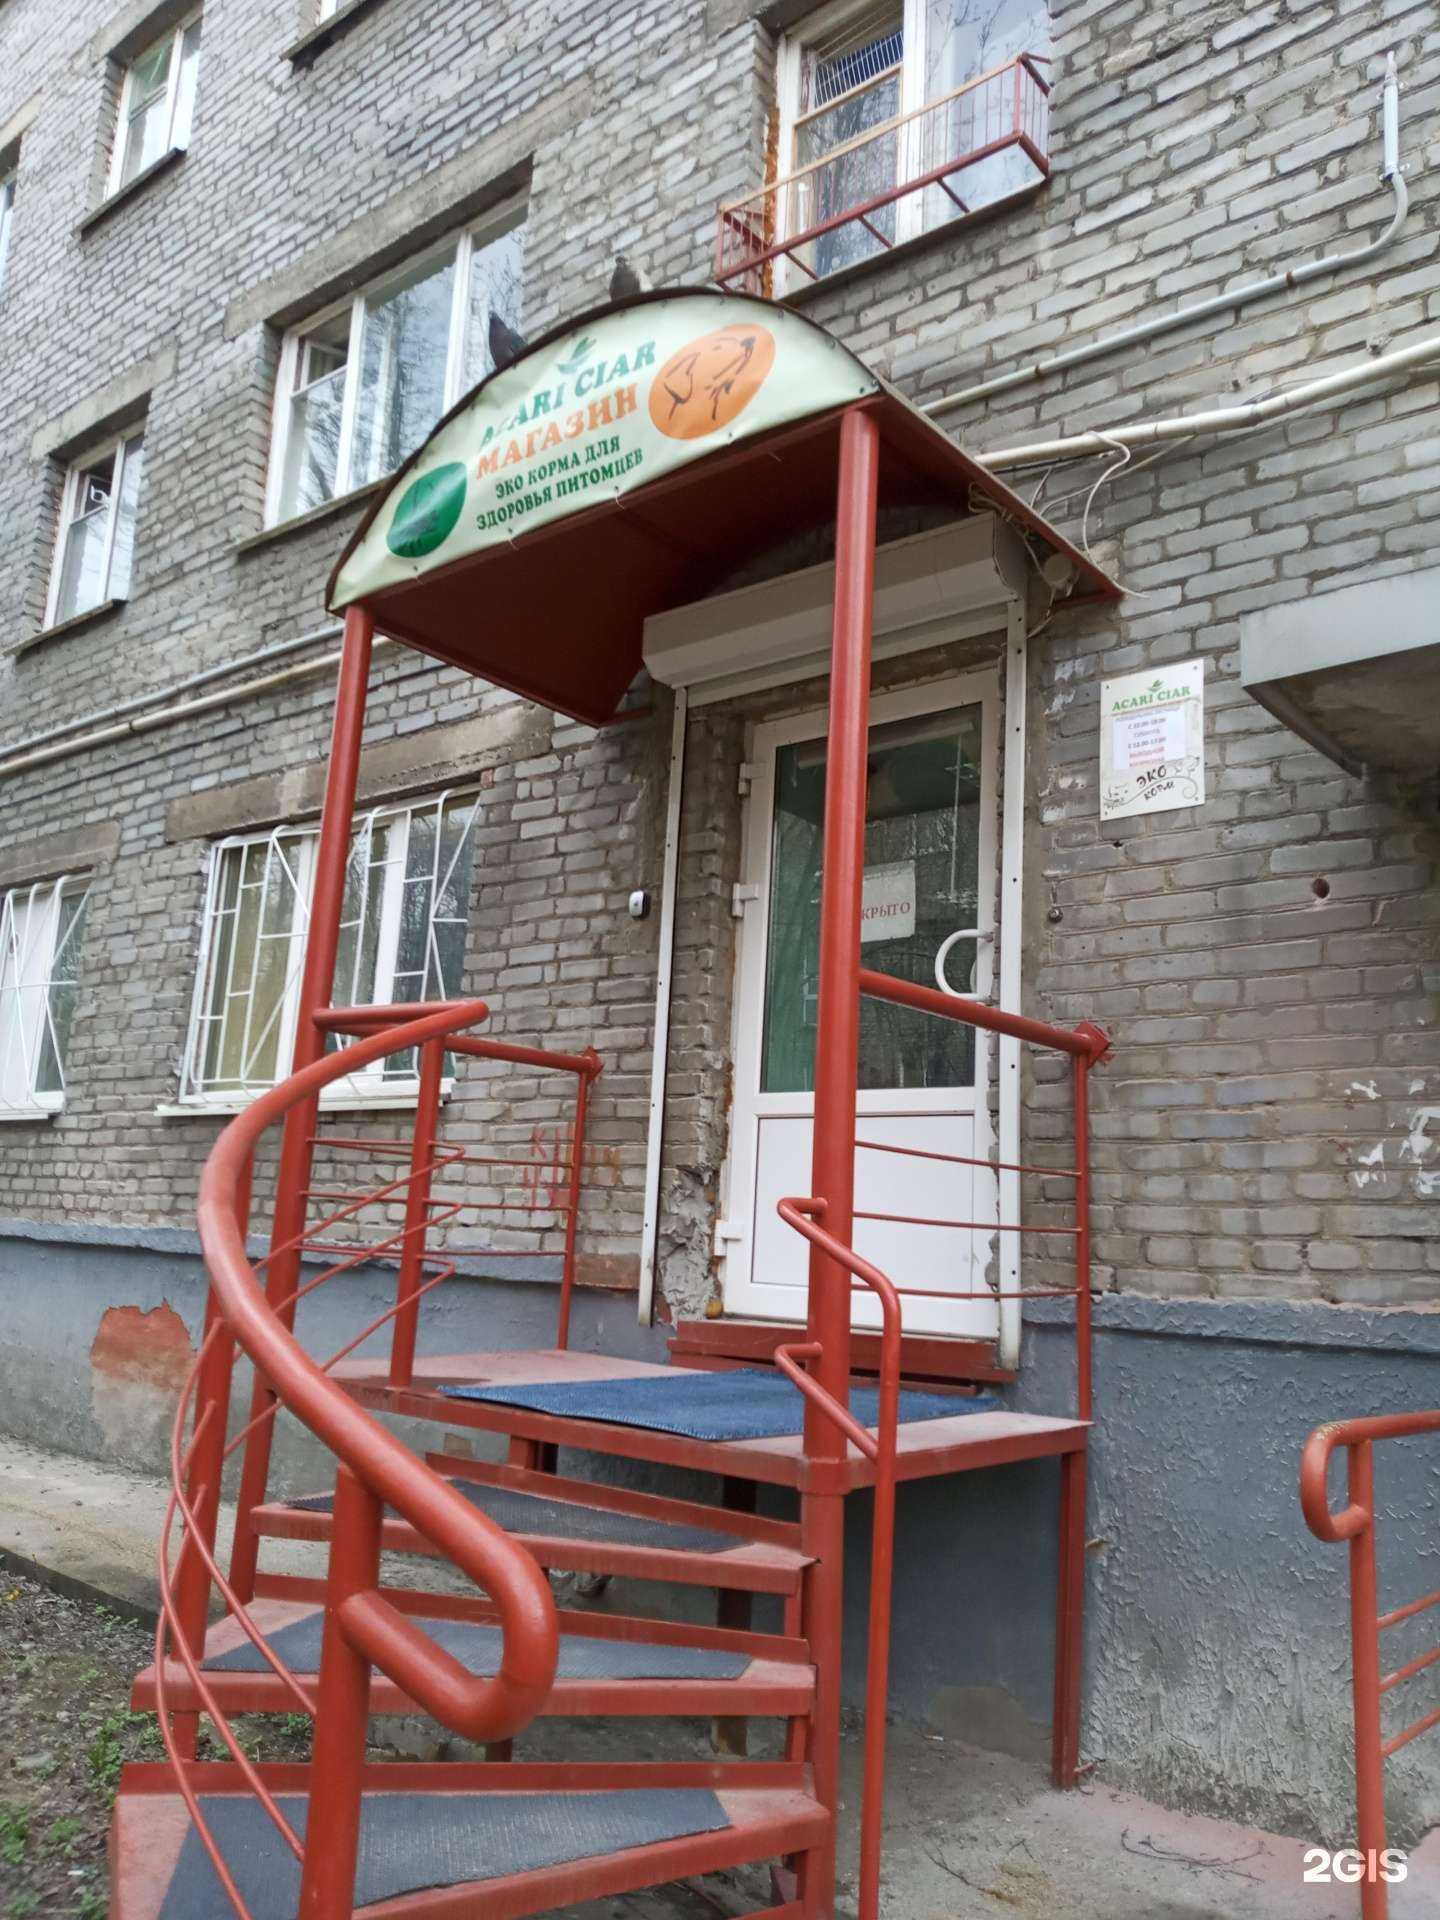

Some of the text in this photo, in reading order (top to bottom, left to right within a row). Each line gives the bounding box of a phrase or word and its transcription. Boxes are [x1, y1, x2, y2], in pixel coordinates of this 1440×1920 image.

[575, 341, 656, 397] CIAR
[476, 382, 638, 480] МАГАЗИН
[476, 448, 644, 530] ЗДОРОВЬЯ ПИТОМЦЕВ
[495, 435, 620, 499] ЭКО КОРМА ДЛЯ
[1112, 686, 1191, 711] ACARI CIAR
[1136, 765, 1167, 789] ЭКО
[862, 902, 911, 920] КРЫТО
